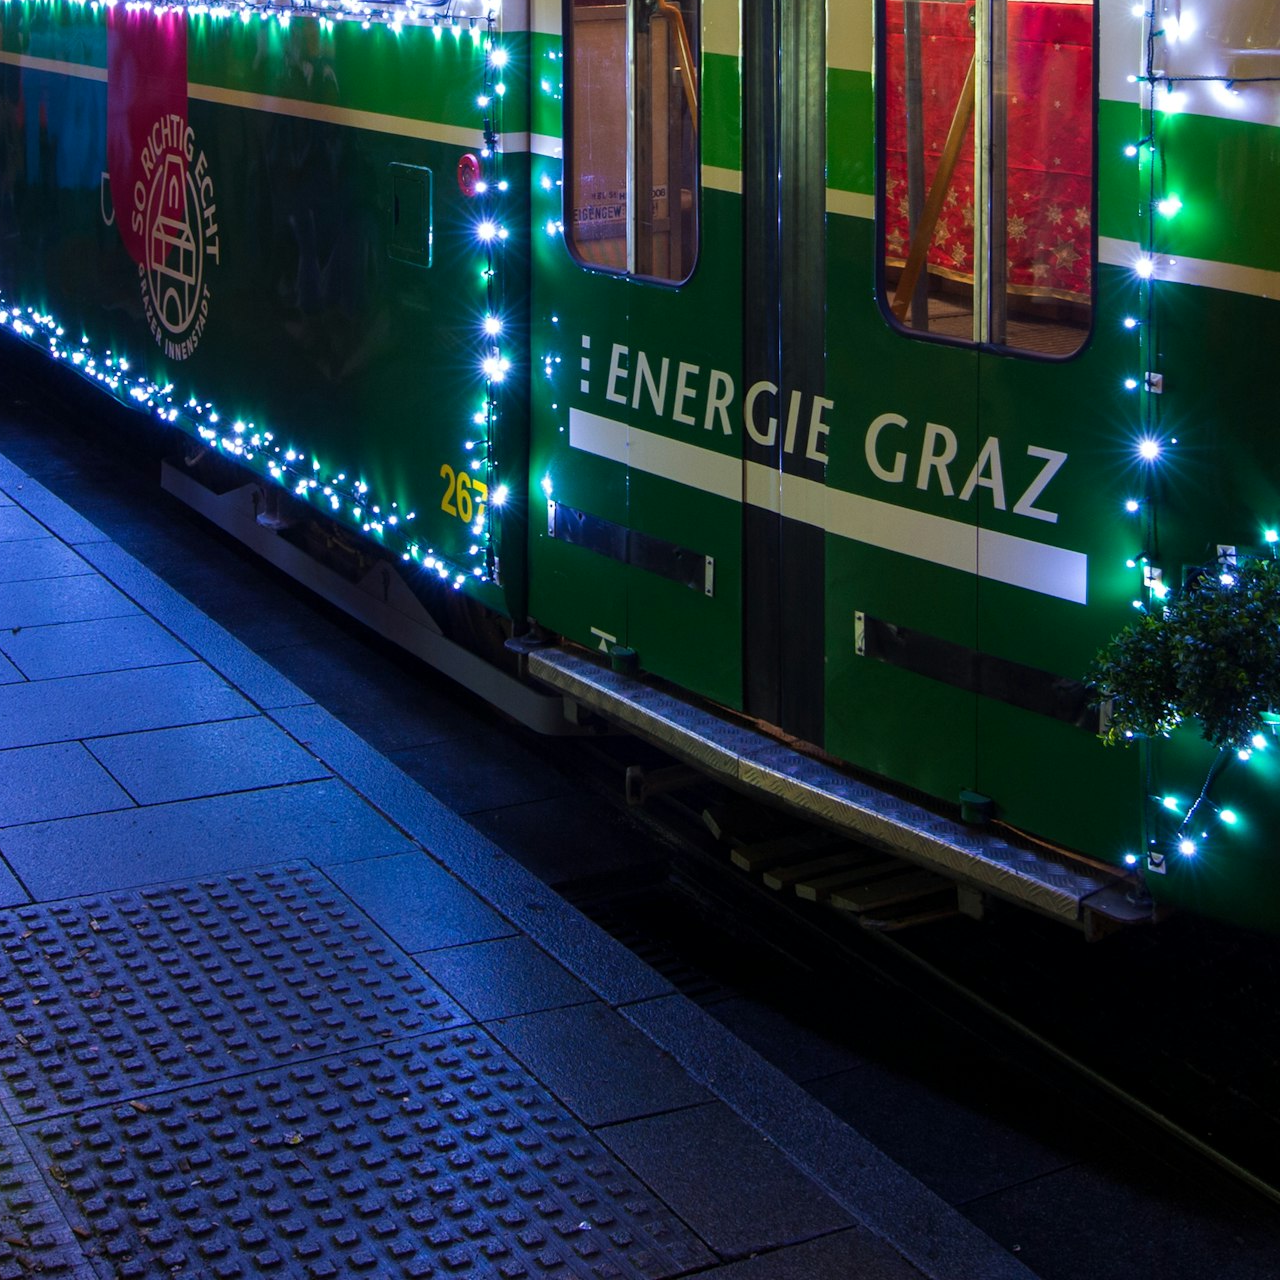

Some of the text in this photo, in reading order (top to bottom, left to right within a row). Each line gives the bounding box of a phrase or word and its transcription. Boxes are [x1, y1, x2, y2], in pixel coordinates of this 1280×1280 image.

[131, 114, 220, 266] SO RICHTIG ECHT
[138, 261, 211, 362] GRAZER INNENSTADT
[440, 463, 489, 524] 267
[605, 343, 1069, 524] ENERGIE GRAZ
